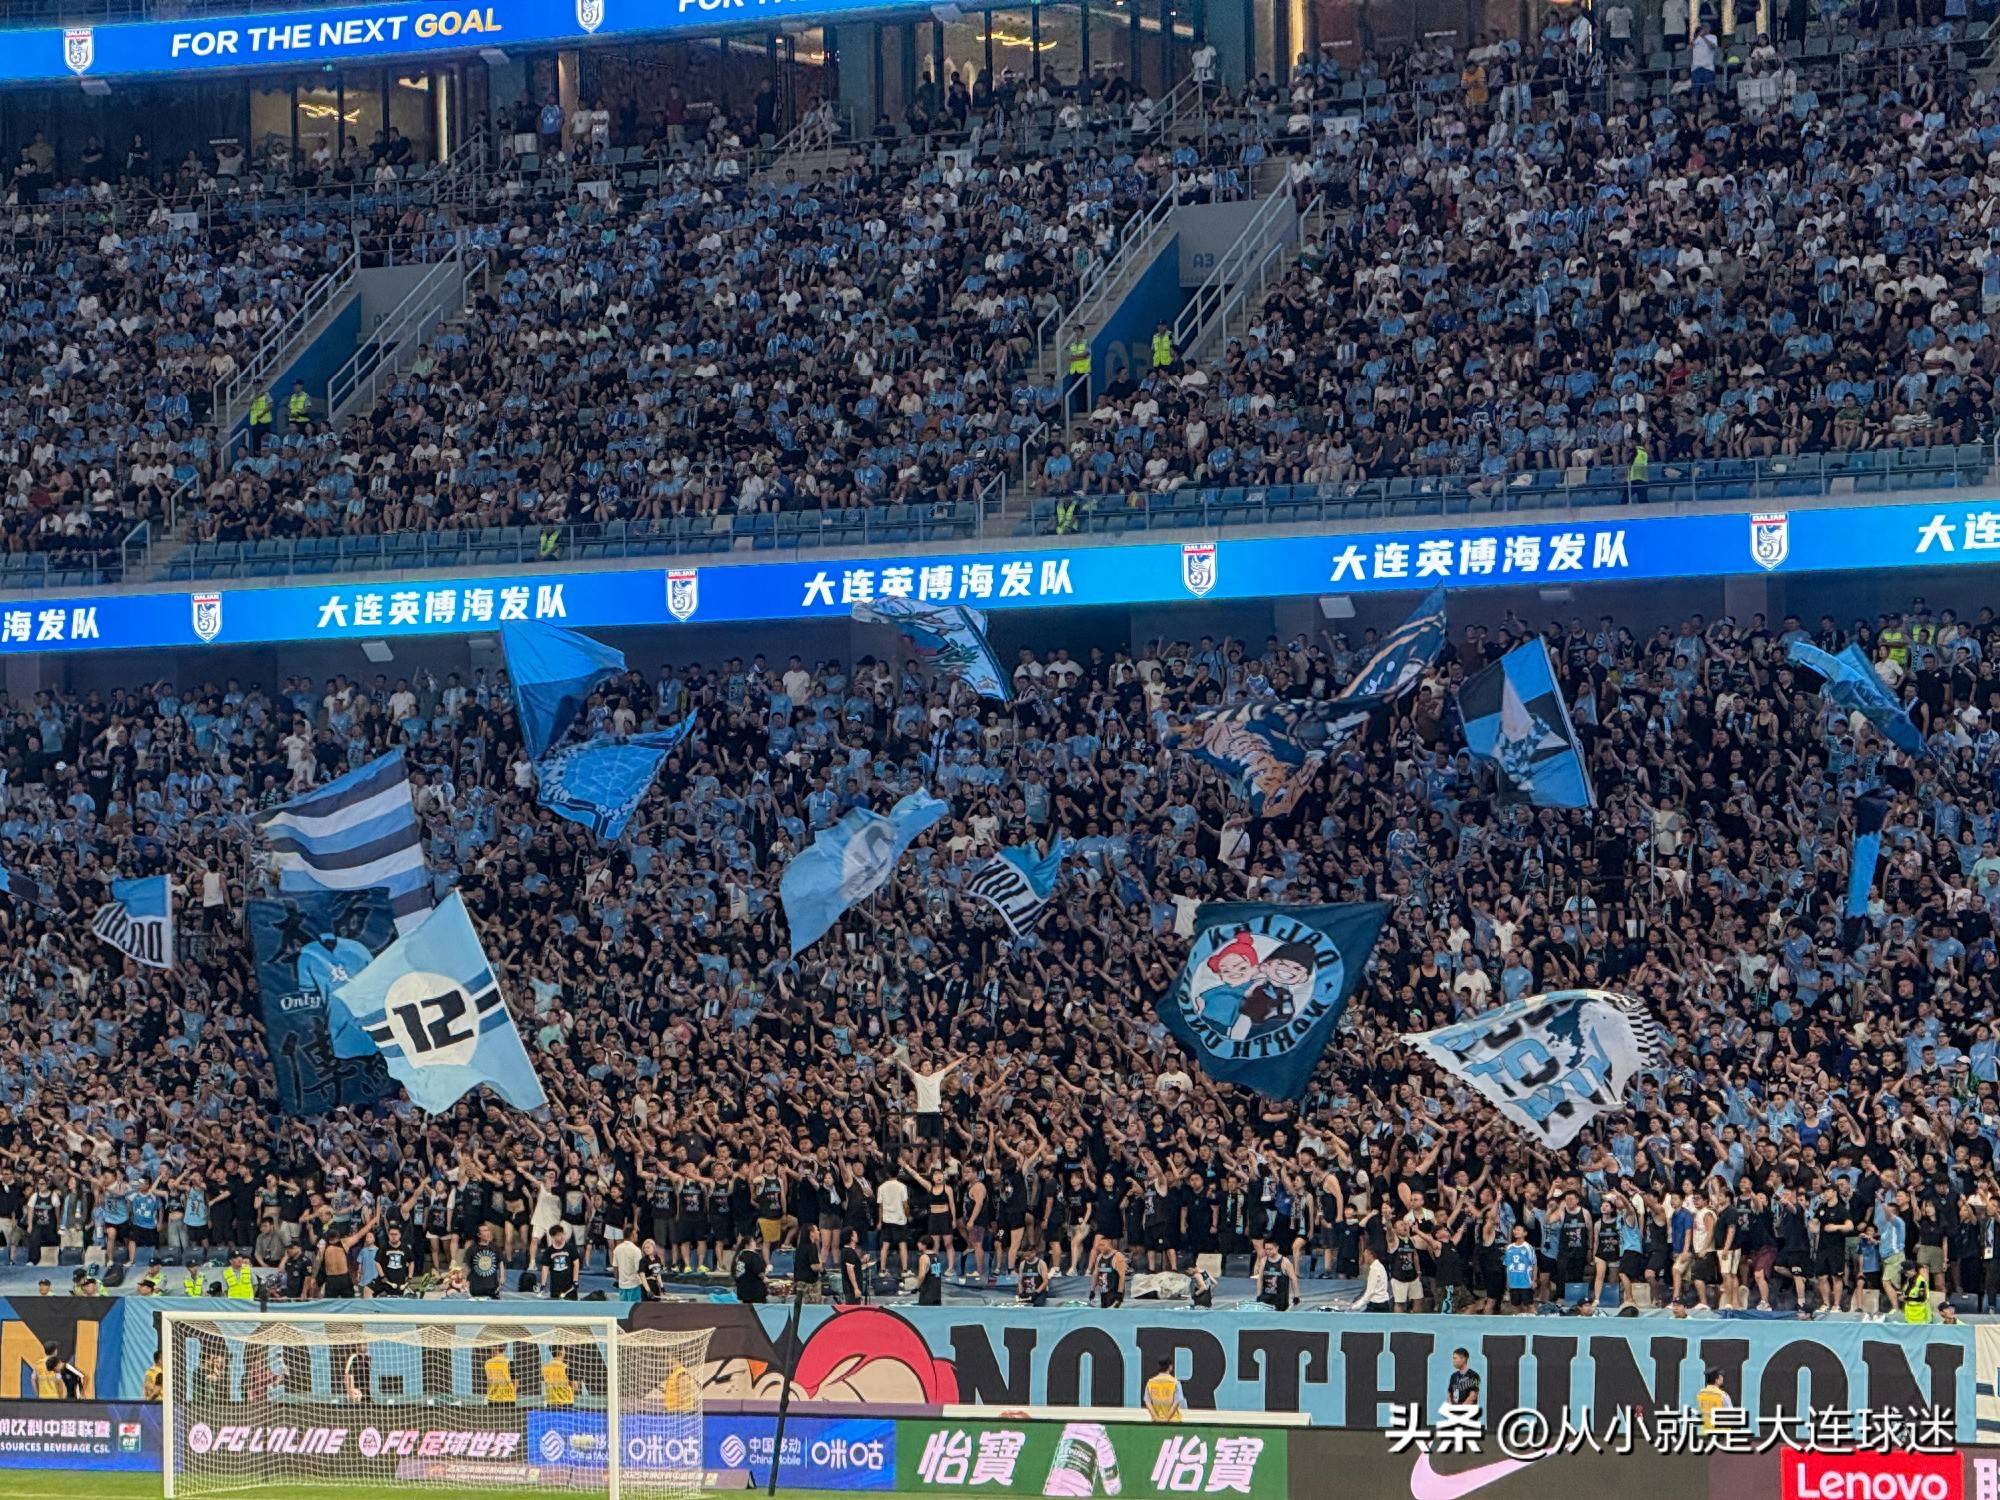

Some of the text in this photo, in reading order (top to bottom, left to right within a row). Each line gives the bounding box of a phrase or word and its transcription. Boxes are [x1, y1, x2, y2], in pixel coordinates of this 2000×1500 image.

[171, 7, 502, 57] FOR THE NEXT GOAL
[1193, 252, 1214, 268] A3
[1330, 530, 1630, 581] 大连英博海发队
[801, 559, 1075, 606] 大连英博海发队
[316, 583, 568, 627] 大连英博海发队
[1, 606, 100, 643] 海发队
[279, 992, 322, 1011] Only
[392, 989, 474, 1053] 12
[949, 1323, 1966, 1442] NORTH UNION
[47, 1442, 91, 1453] BEVERAGE
[93, 1444, 110, 1453] CSL
[212, 1426, 250, 1451] FC
[381, 1430, 520, 1457] FC 足球世界
[629, 1435, 699, 1464] 咪咕
[811, 1438, 884, 1470] 咪咕
[1796, 1463, 1949, 1500] Lenovo
